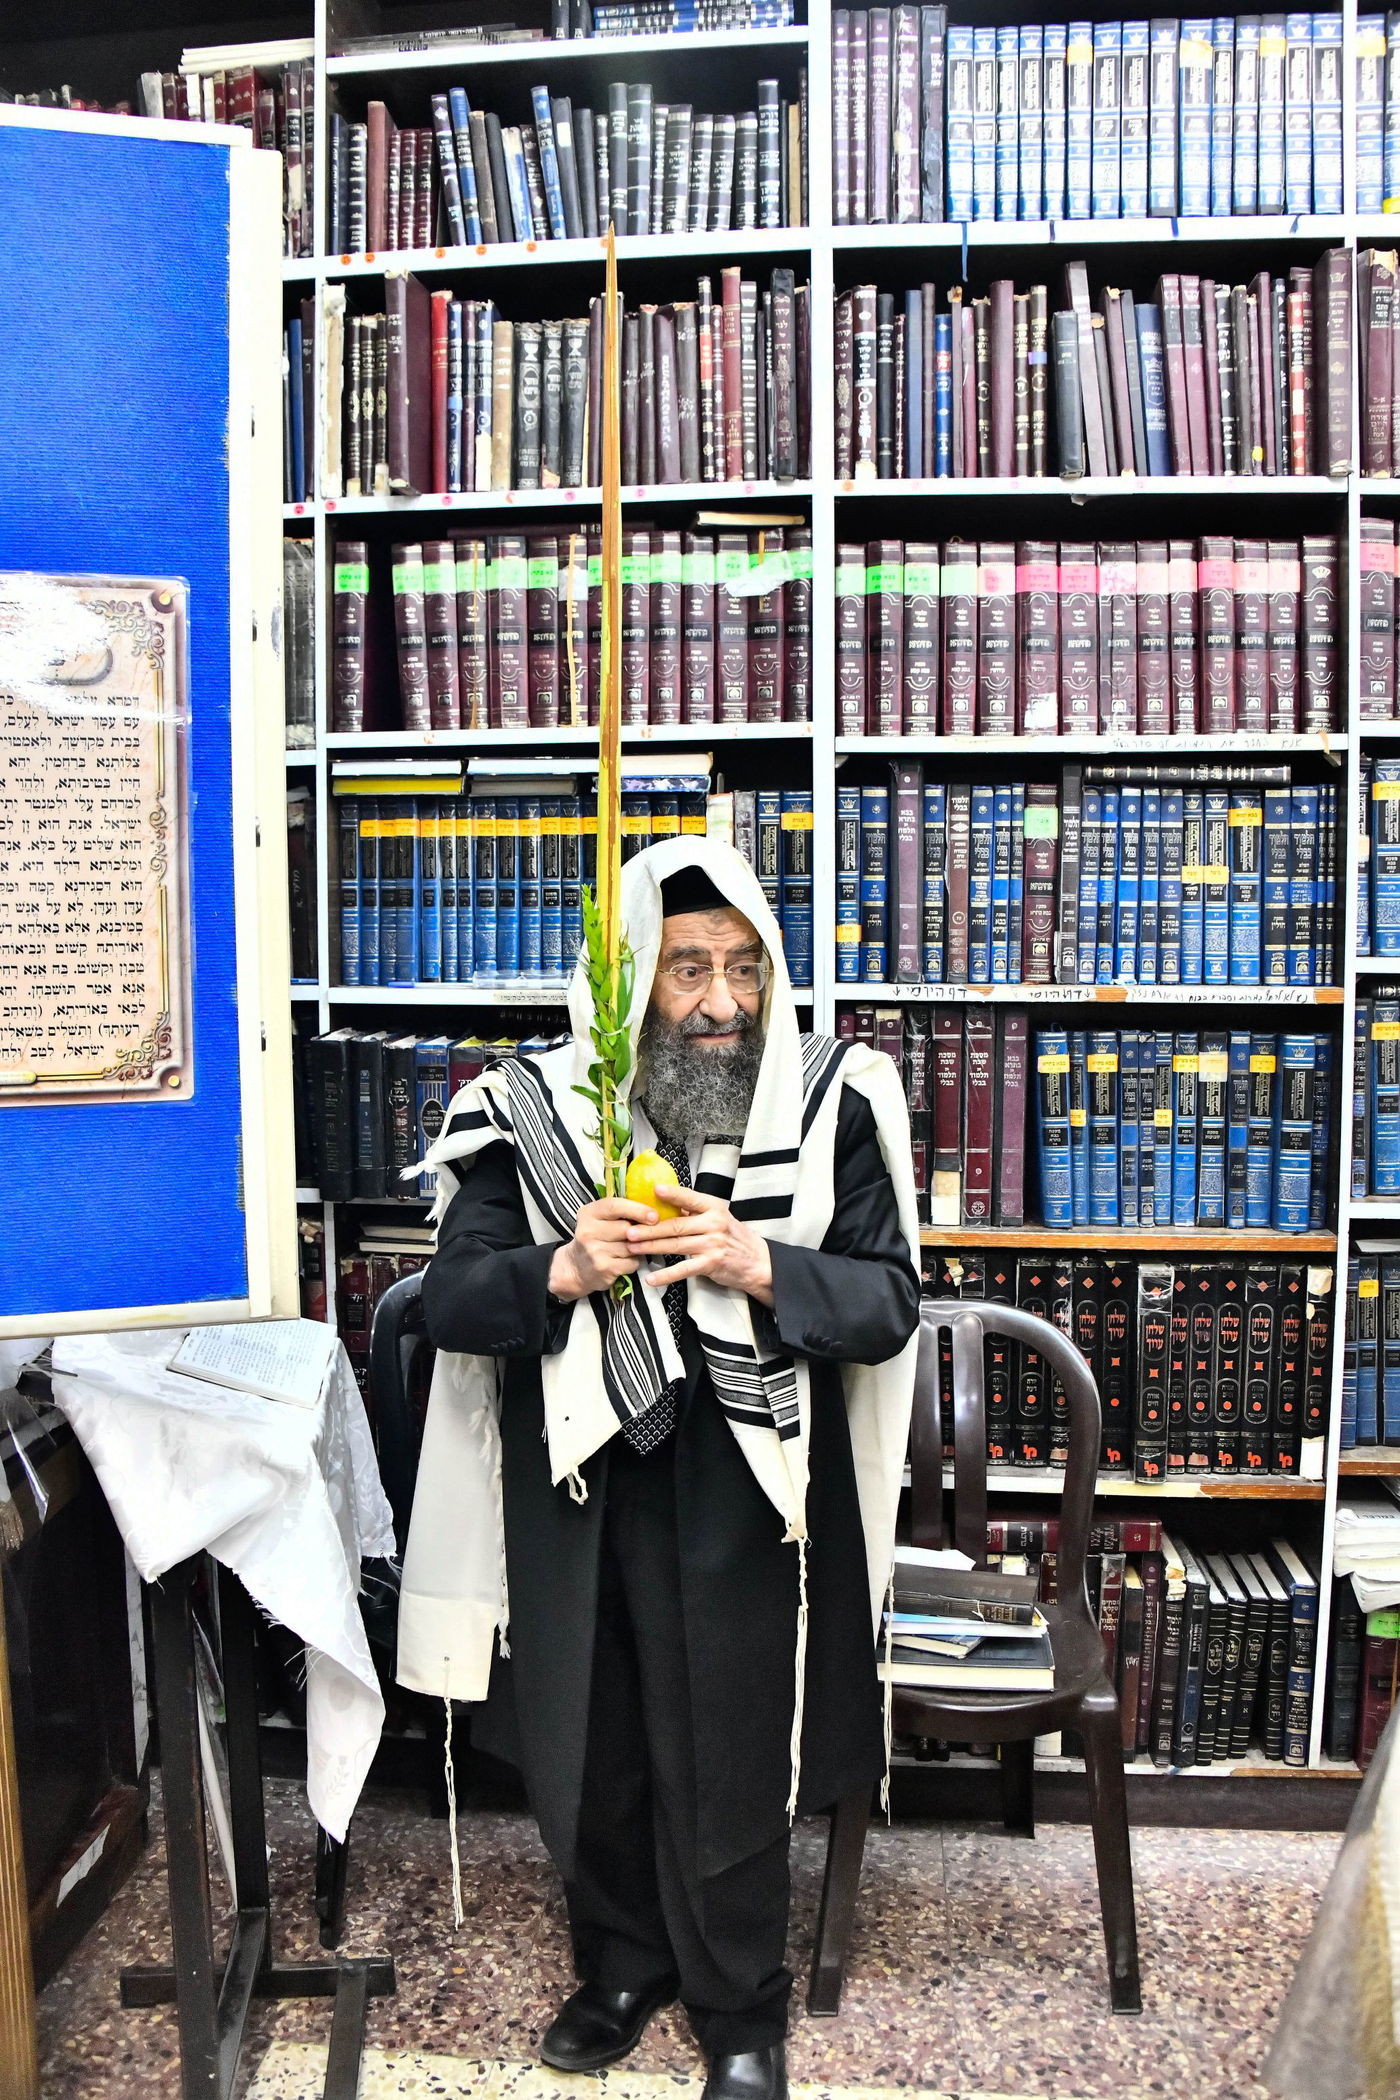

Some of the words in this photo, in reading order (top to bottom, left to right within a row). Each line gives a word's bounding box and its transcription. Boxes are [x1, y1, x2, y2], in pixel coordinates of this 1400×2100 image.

[1079, 1309, 1096, 1328] שלחן
[1107, 1308, 1126, 1327] שלחן
[1194, 1312, 1212, 1331] שלחן
[1221, 1311, 1239, 1334] שלחן
[1252, 1312, 1270, 1333] שלחן
[1108, 1327, 1124, 1341] ערוך
[1146, 1319, 1164, 1338] שלחן
[1221, 1330, 1239, 1346] ערוך
[1146, 1339, 1163, 1352] ערוך
[1252, 1331, 1269, 1346] ערוך
